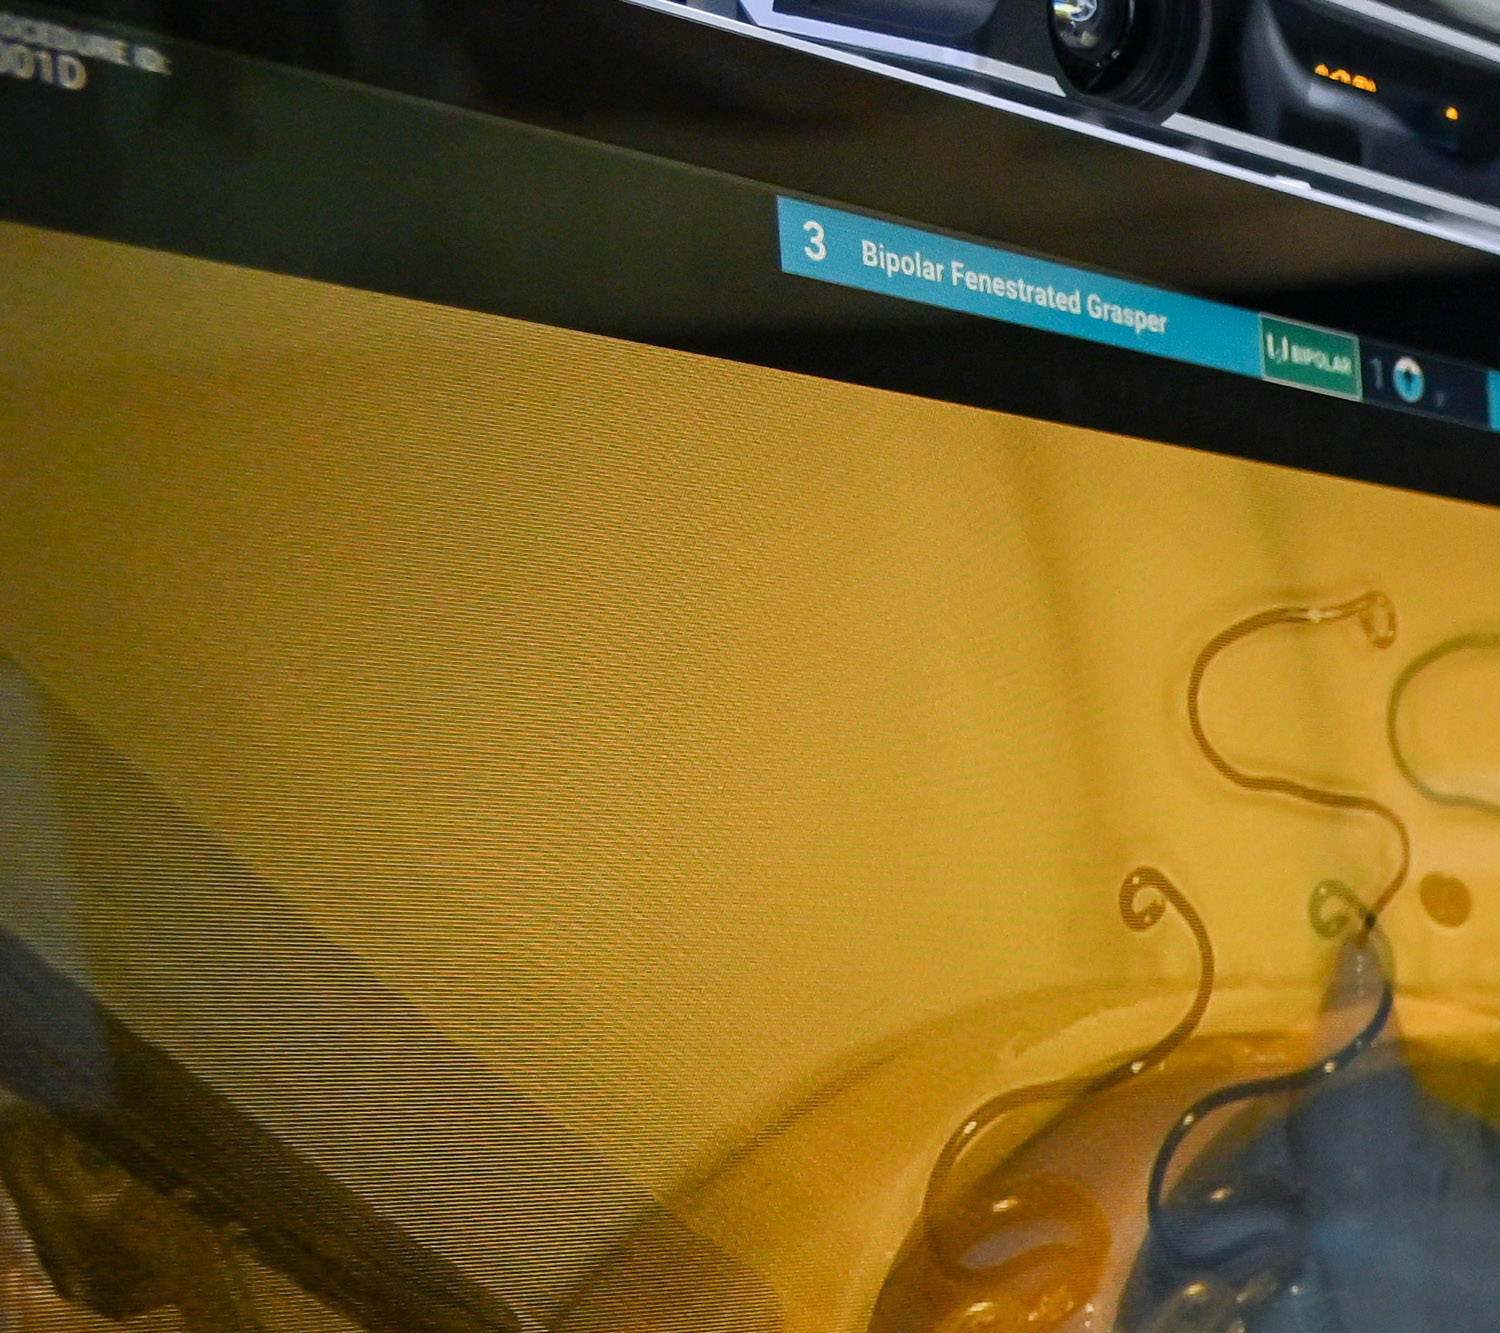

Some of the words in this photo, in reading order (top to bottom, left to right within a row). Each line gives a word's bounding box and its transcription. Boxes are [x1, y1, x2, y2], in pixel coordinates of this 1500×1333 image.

[803, 220, 827, 261] 3
[861, 239, 944, 282] Bipolar
[951, 260, 1082, 316] Fenestrated
[1086, 292, 1168, 336] Grasper
[1290, 344, 1352, 376] BIPOLAR
